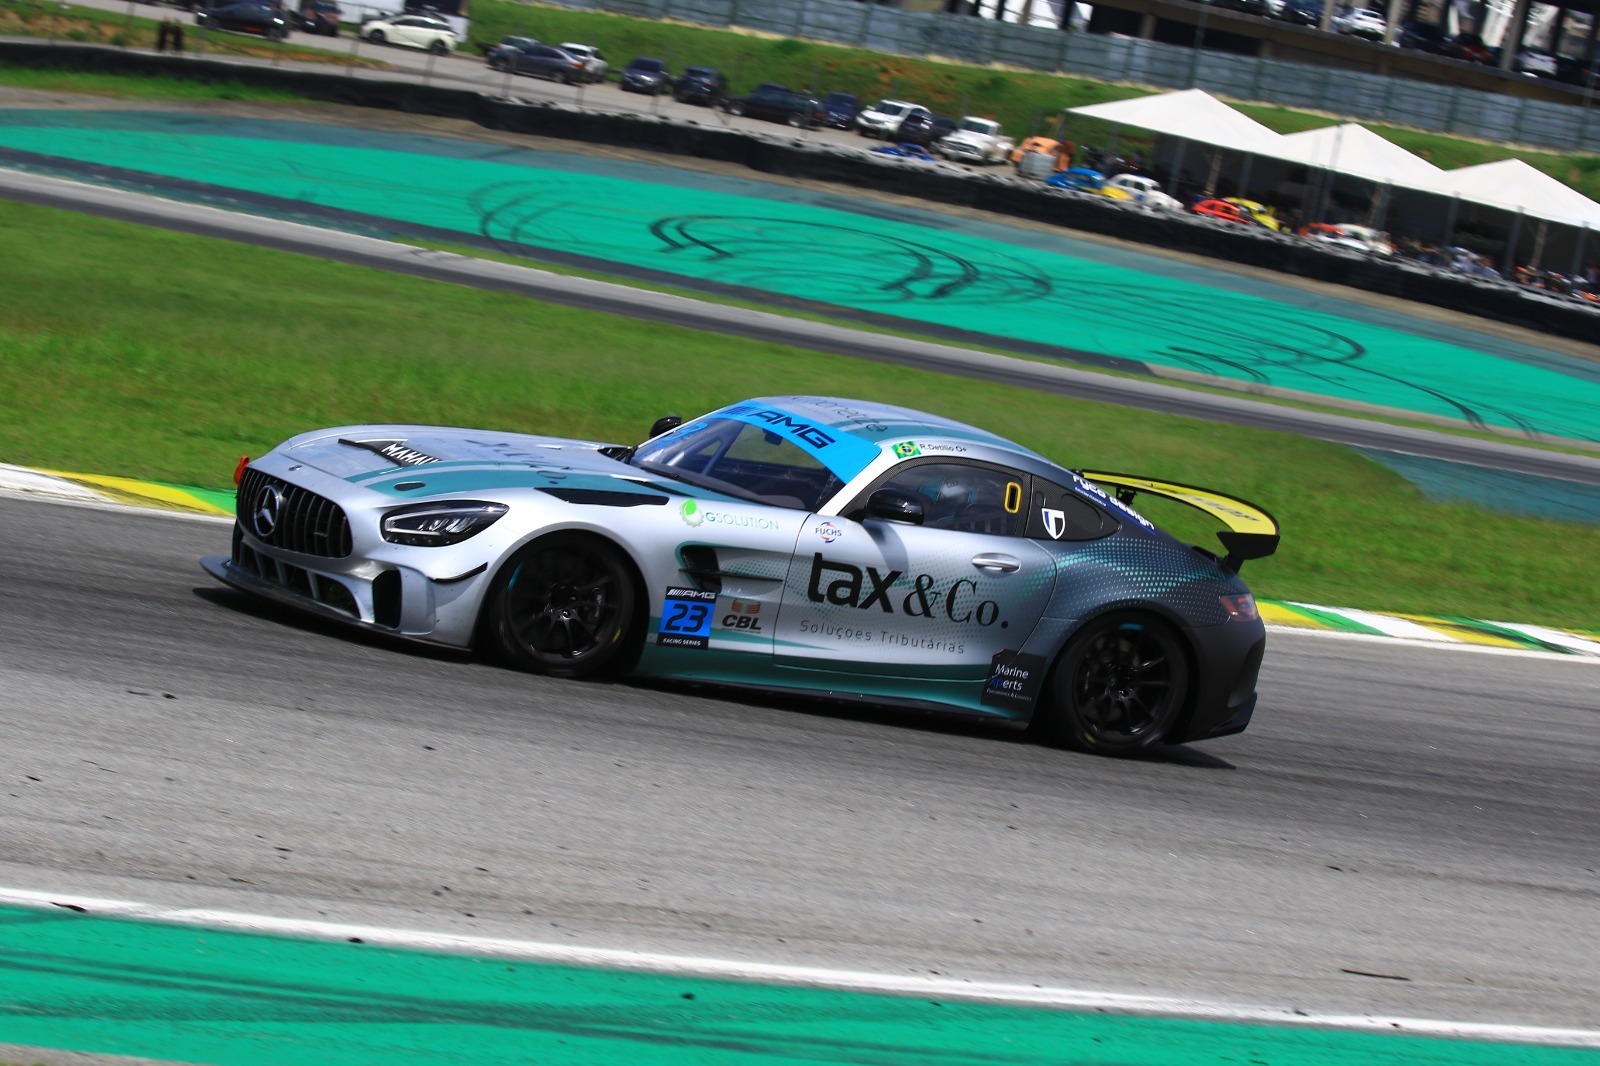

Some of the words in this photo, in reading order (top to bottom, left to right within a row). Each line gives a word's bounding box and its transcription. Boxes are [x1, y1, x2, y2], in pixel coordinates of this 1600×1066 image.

[749, 410, 836, 449] AMG
[705, 511, 779, 530] GSOLUTION
[1109, 496, 1156, 531] design
[815, 526, 842, 537] FUCHS
[807, 551, 903, 614] tax
[682, 590, 716, 599] AMG
[664, 603, 709, 633] 23
[722, 614, 762, 631] CBL
[662, 637, 682, 645] RACING
[880, 630, 966, 654] Tributárias
[995, 663, 1029, 680] Marine
